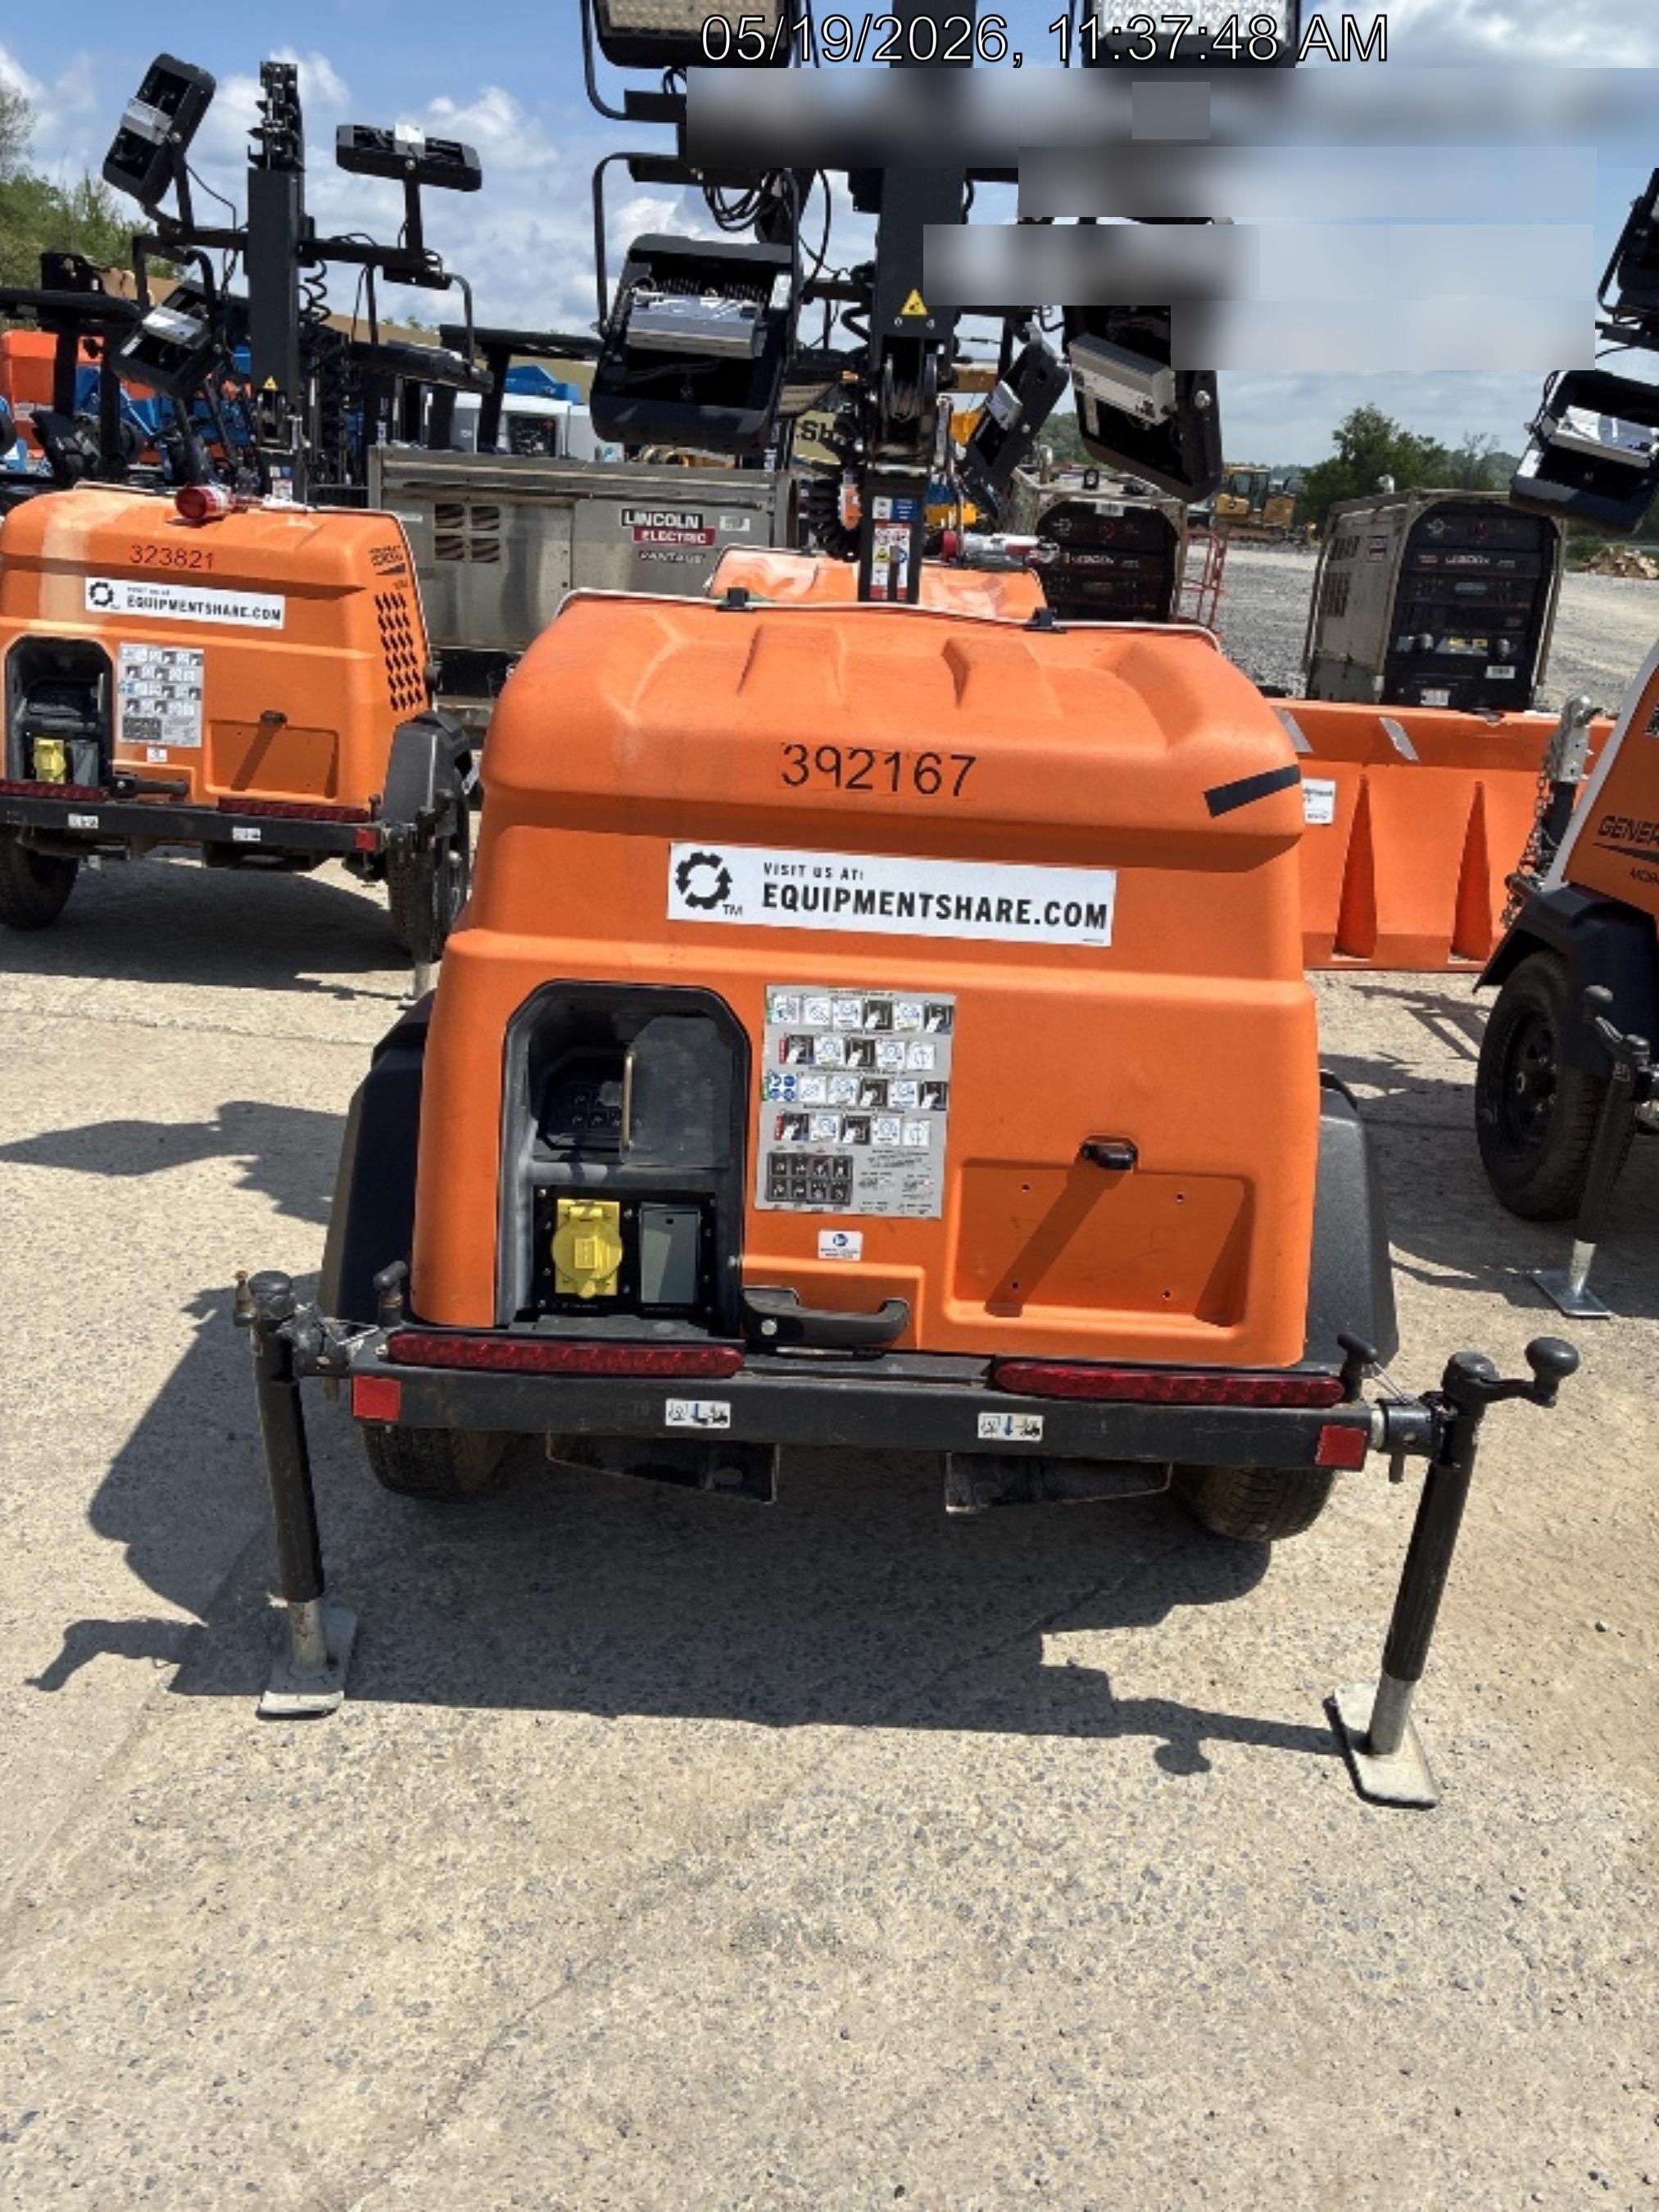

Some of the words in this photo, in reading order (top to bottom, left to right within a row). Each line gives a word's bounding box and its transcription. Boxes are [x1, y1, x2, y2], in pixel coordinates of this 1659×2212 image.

[625, 510, 699, 528] LINCOLN
[641, 529, 706, 543] ELECTRIC
[130, 545, 214, 569] 323821
[127, 595, 280, 620] EQUIPMENTSHARE.COM
[782, 744, 977, 796] 392167
[764, 863, 806, 877] VISIT
[813, 867, 832, 878] US
[841, 868, 863, 881] AT:
[762, 882, 1107, 929] EQUIPMENTSHARE.COM
